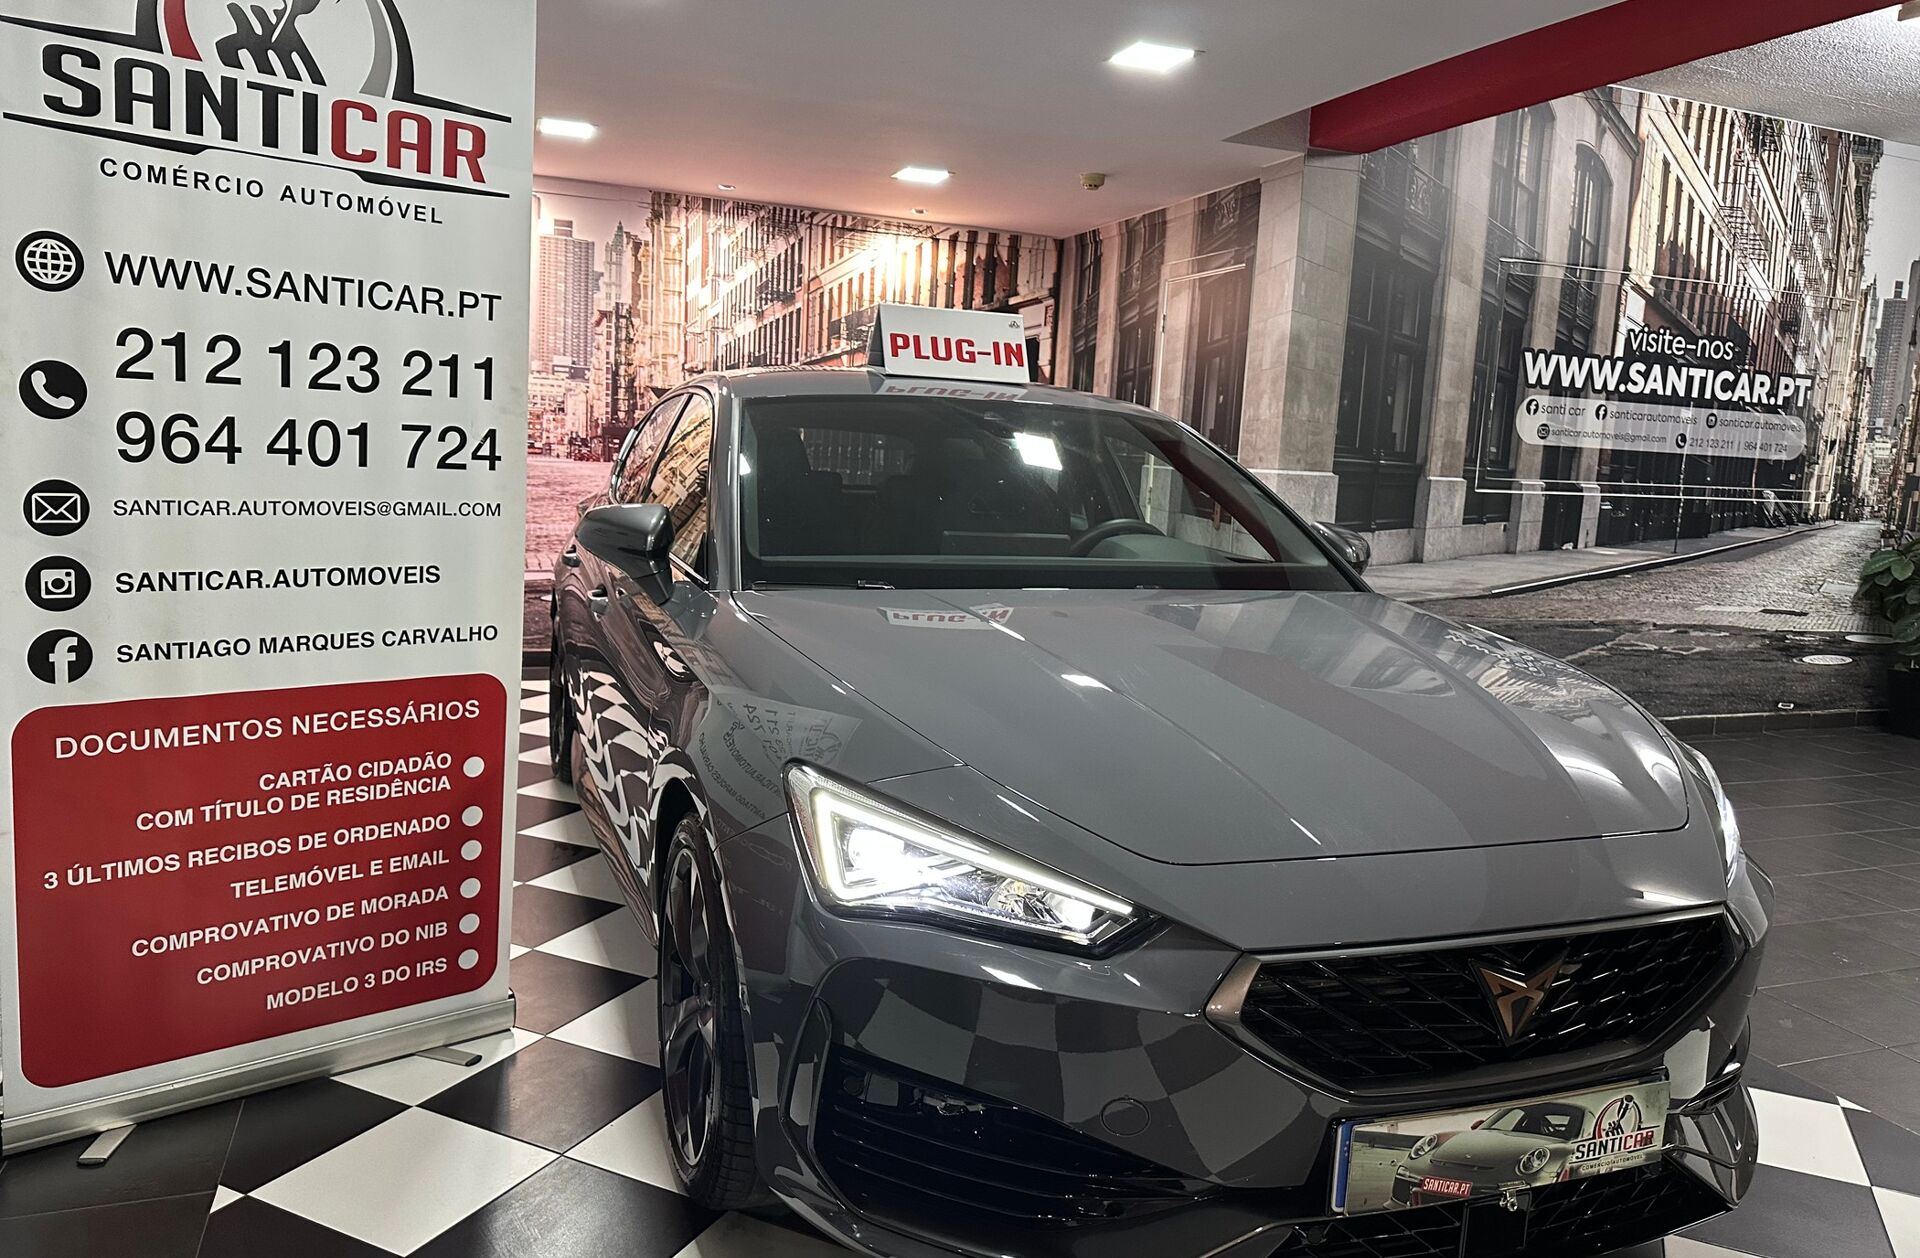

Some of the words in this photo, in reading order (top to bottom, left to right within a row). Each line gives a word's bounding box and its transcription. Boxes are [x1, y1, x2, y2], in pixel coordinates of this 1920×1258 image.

[42, 44, 486, 183] SANTICAR
[100, 158, 263, 197] COMÉRCIO
[280, 185, 442, 224] AUTOMÓVEL
[104, 252, 501, 321] WWW.SANTICAR.PT
[116, 328, 241, 385] 212
[269, 340, 379, 393] 123
[402, 350, 492, 400] 211
[889, 332, 1024, 368] PLUG-IN
[1628, 327, 1735, 360] visite-nos
[1524, 351, 1812, 407] WWW.SANTICAR.PT
[1541, 403, 1566, 415] santi
[1569, 408, 1586, 417] car
[117, 412, 242, 464] 964
[267, 419, 367, 467] 401
[402, 424, 501, 471] 724
[114, 500, 500, 516] SANTICAR.AUTOMOVEIS@GMAIL.COM
[116, 565, 440, 593] SANTICAR.AUTOMOVEIS
[117, 638, 250, 663] SANTIAGO
[260, 632, 374, 654] MARQUES
[382, 625, 497, 646] CARVALHO
[56, 718, 282, 758] DOCUMENTOS
[293, 700, 479, 735] NECESSÁRIOS
[260, 763, 351, 790] CARTÃO
[358, 752, 451, 782] CIDADÃO
[137, 809, 193, 830] COM
[200, 797, 283, 822] TÍTULO
[291, 792, 319, 810] DE
[327, 776, 451, 805] RESIDÊNCIA
[44, 872, 58, 889] 3
[68, 854, 180, 885] ÚLTIMOS
[189, 838, 291, 868] RECIBOS
[299, 832, 327, 851] DE
[334, 815, 450, 845] ORDENADO
[230, 864, 363, 898] TELEMÓVEL
[371, 860, 382, 875] E
[390, 850, 449, 872] EMAIL
[132, 909, 319, 957] COMPROVATIVO
[327, 902, 354, 921] DE
[362, 887, 448, 914] MORADA
[197, 936, 375, 985] COMPROVATIVO
[381, 930, 409, 947] DO
[416, 922, 447, 940] NIB
[267, 977, 358, 1009] MODELO
[365, 974, 375, 988] 3
[382, 966, 410, 984] DO
[417, 958, 446, 977] IRS
[1575, 1130, 1654, 1160] SANTICAR
[1423, 1178, 1470, 1195] SANTICAR.PT
